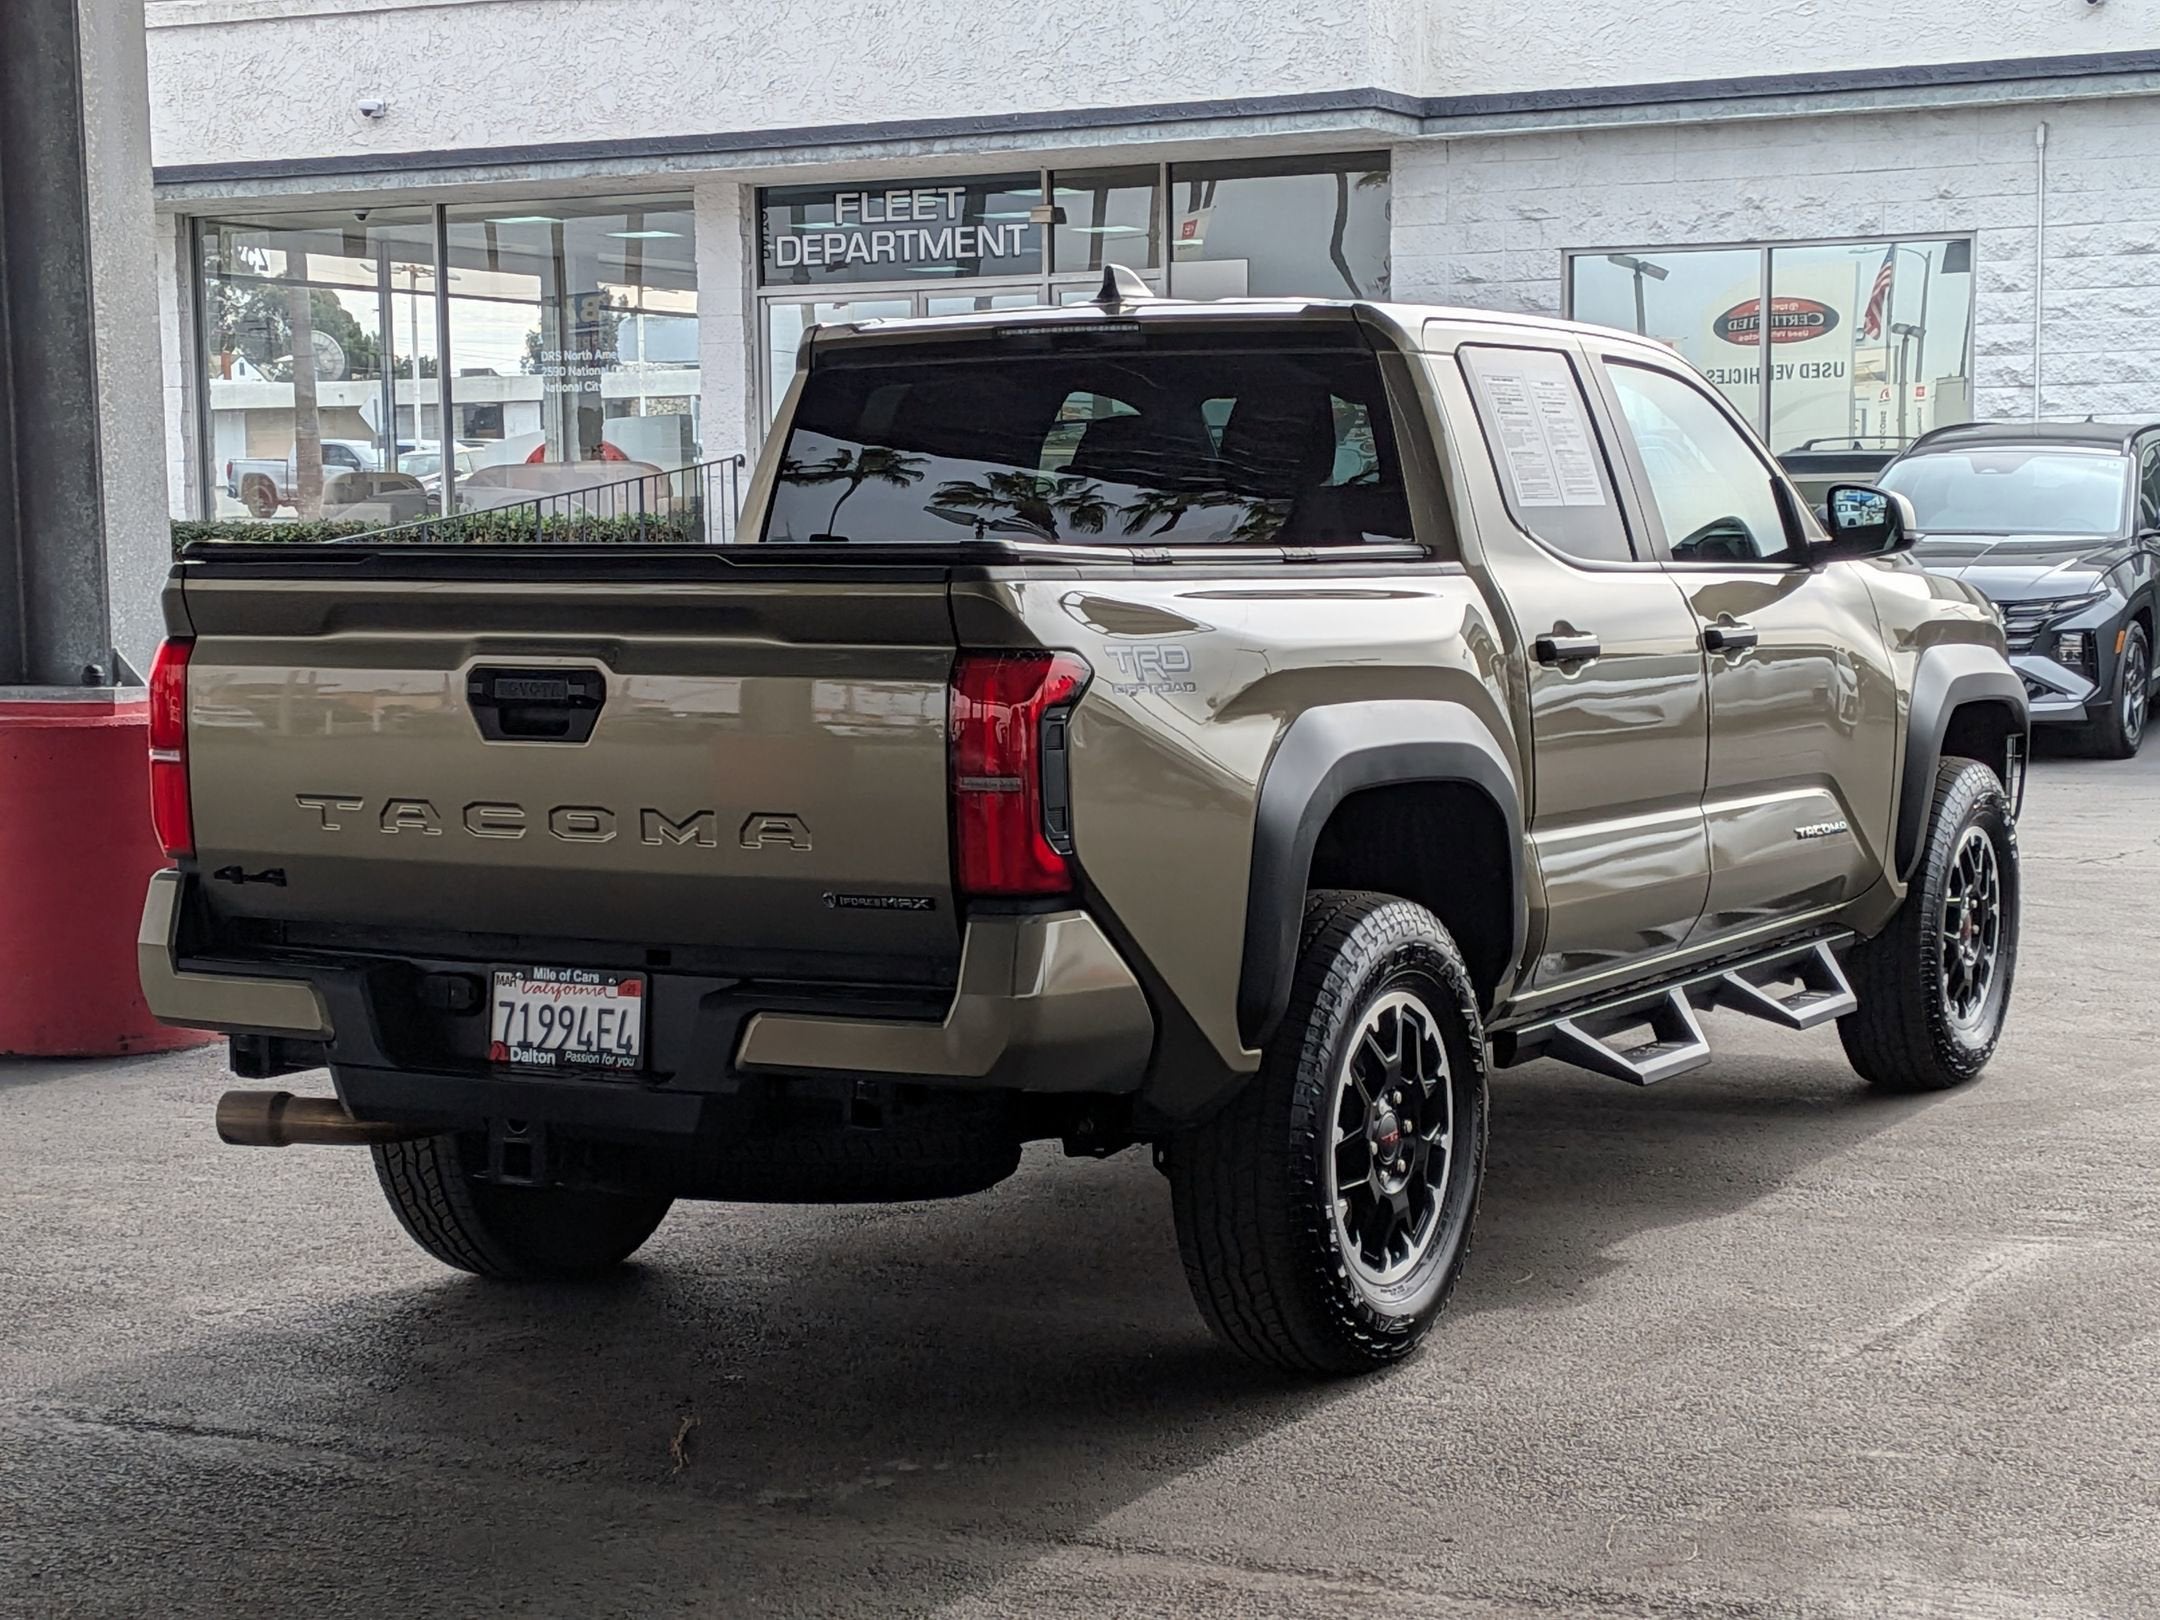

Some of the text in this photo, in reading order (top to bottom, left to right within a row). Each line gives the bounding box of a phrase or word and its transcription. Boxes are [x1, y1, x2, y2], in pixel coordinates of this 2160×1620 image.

[835, 186, 967, 225] FLEET
[775, 223, 1029, 267] DEPARTMENT
[541, 351, 562, 361] DRS
[564, 349, 593, 361] North
[1103, 644, 1193, 681] TRD
[295, 793, 812, 851] TACOMA
[533, 968, 600, 983] Mile of Cars
[522, 980, 617, 1002] California
[499, 1001, 633, 1053] 71994E4
[510, 1046, 556, 1066] Dalton
[564, 1051, 635, 1068] Passion for you
